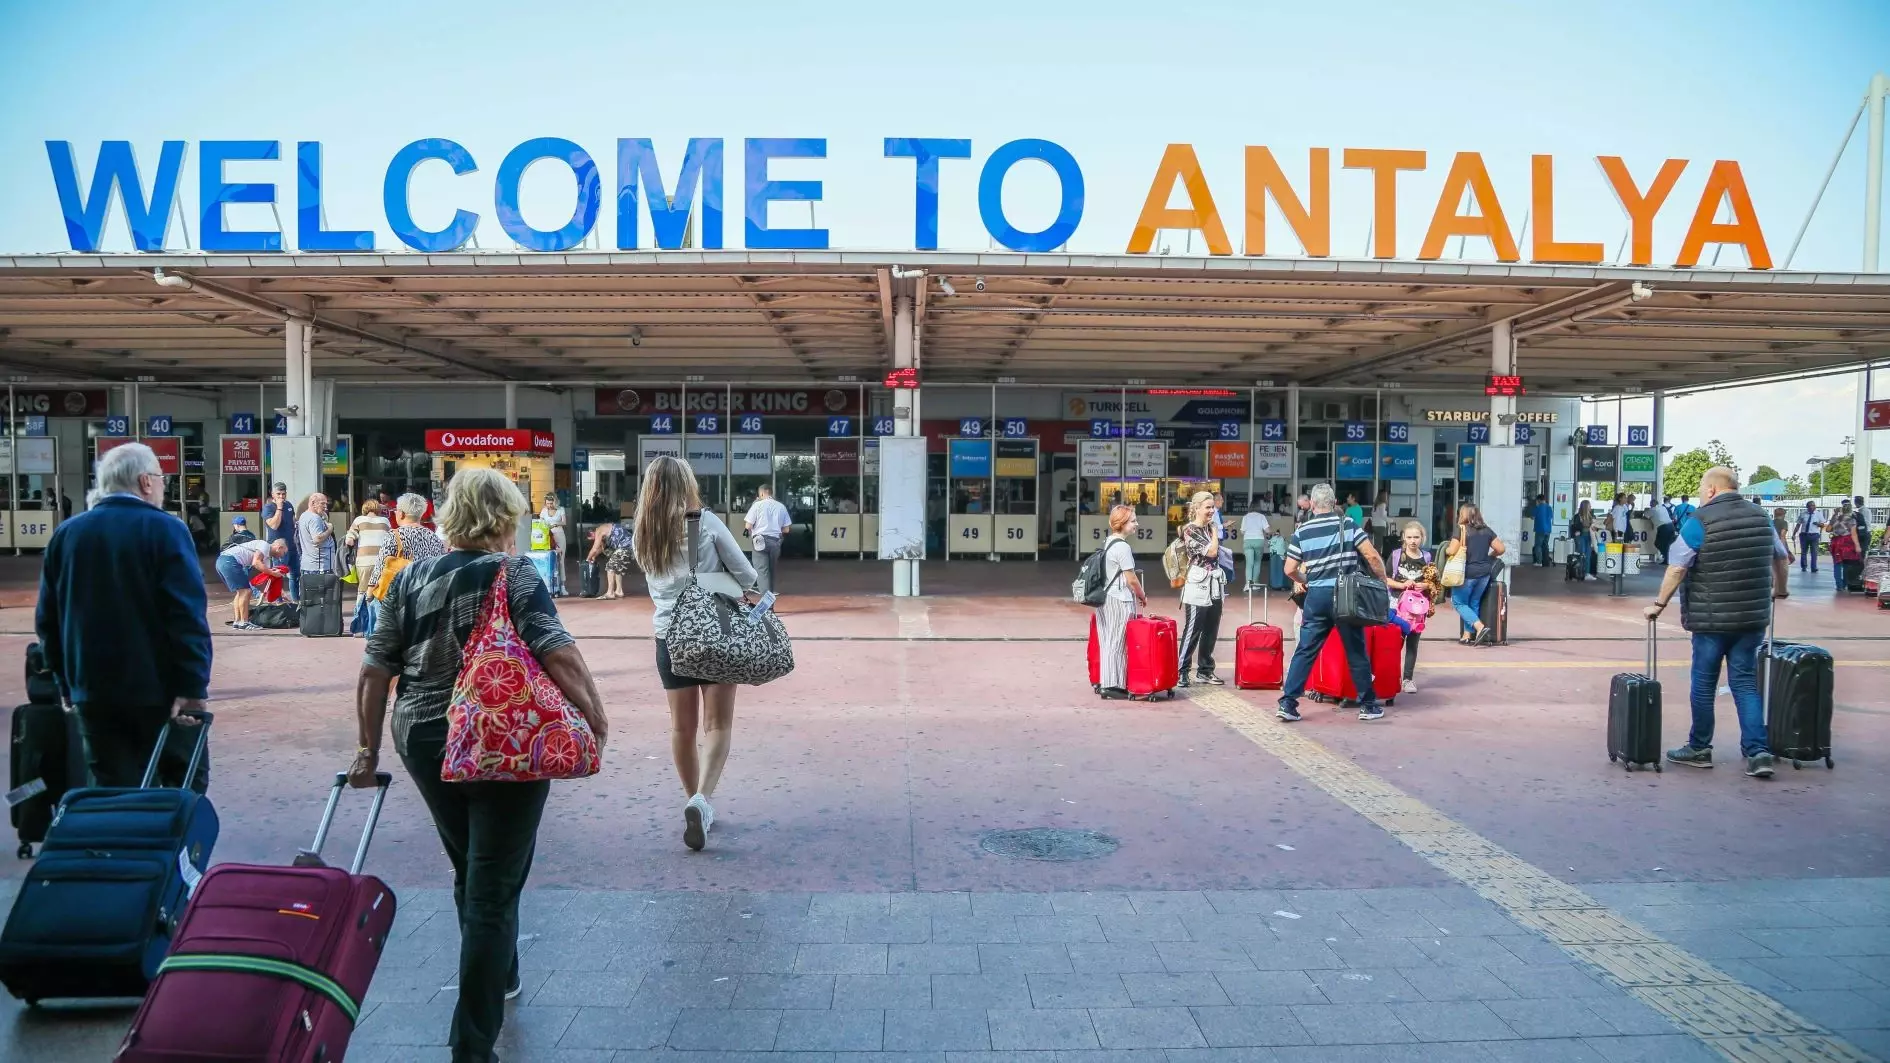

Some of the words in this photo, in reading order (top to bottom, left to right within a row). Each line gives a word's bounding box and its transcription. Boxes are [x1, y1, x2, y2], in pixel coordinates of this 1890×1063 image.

[45, 137, 829, 252] WELCOME
[884, 138, 1085, 252] TO
[1126, 143, 1772, 269] ANTALYA
[1492, 376, 1521, 386] TAXI
[655, 392, 744, 411] BURGER
[751, 392, 808, 411] KING
[1088, 402, 1151, 412] TURKCELL
[1427, 410, 1491, 422] STARBUC
[1516, 412, 1558, 423] OFFEE
[108, 419, 126, 433] 39
[151, 419, 169, 433] 40
[234, 417, 251, 431] 41
[652, 417, 672, 431] 44
[697, 417, 717, 431] 45
[742, 417, 761, 431] 46
[829, 420, 849, 434] 47
[874, 420, 894, 434] 48
[961, 421, 980, 435] 49
[1007, 421, 1025, 435] 50
[1093, 422, 1110, 436] 51
[1136, 422, 1155, 436] 52
[1221, 423, 1239, 437] 53
[1264, 423, 1282, 437] 54
[1347, 425, 1366, 438] 55
[1389, 425, 1407, 439] 56
[1470, 427, 1488, 440] 57
[1590, 428, 1607, 441] 59
[1630, 429, 1647, 442] 60
[457, 434, 514, 446] vodafone
[659, 450, 678, 458] PEGAS
[831, 527, 847, 539] 47
[962, 528, 979, 539] 49
[1007, 528, 1024, 539] 50
[1093, 529, 1108, 539] 51
[1137, 529, 1153, 539] 52
